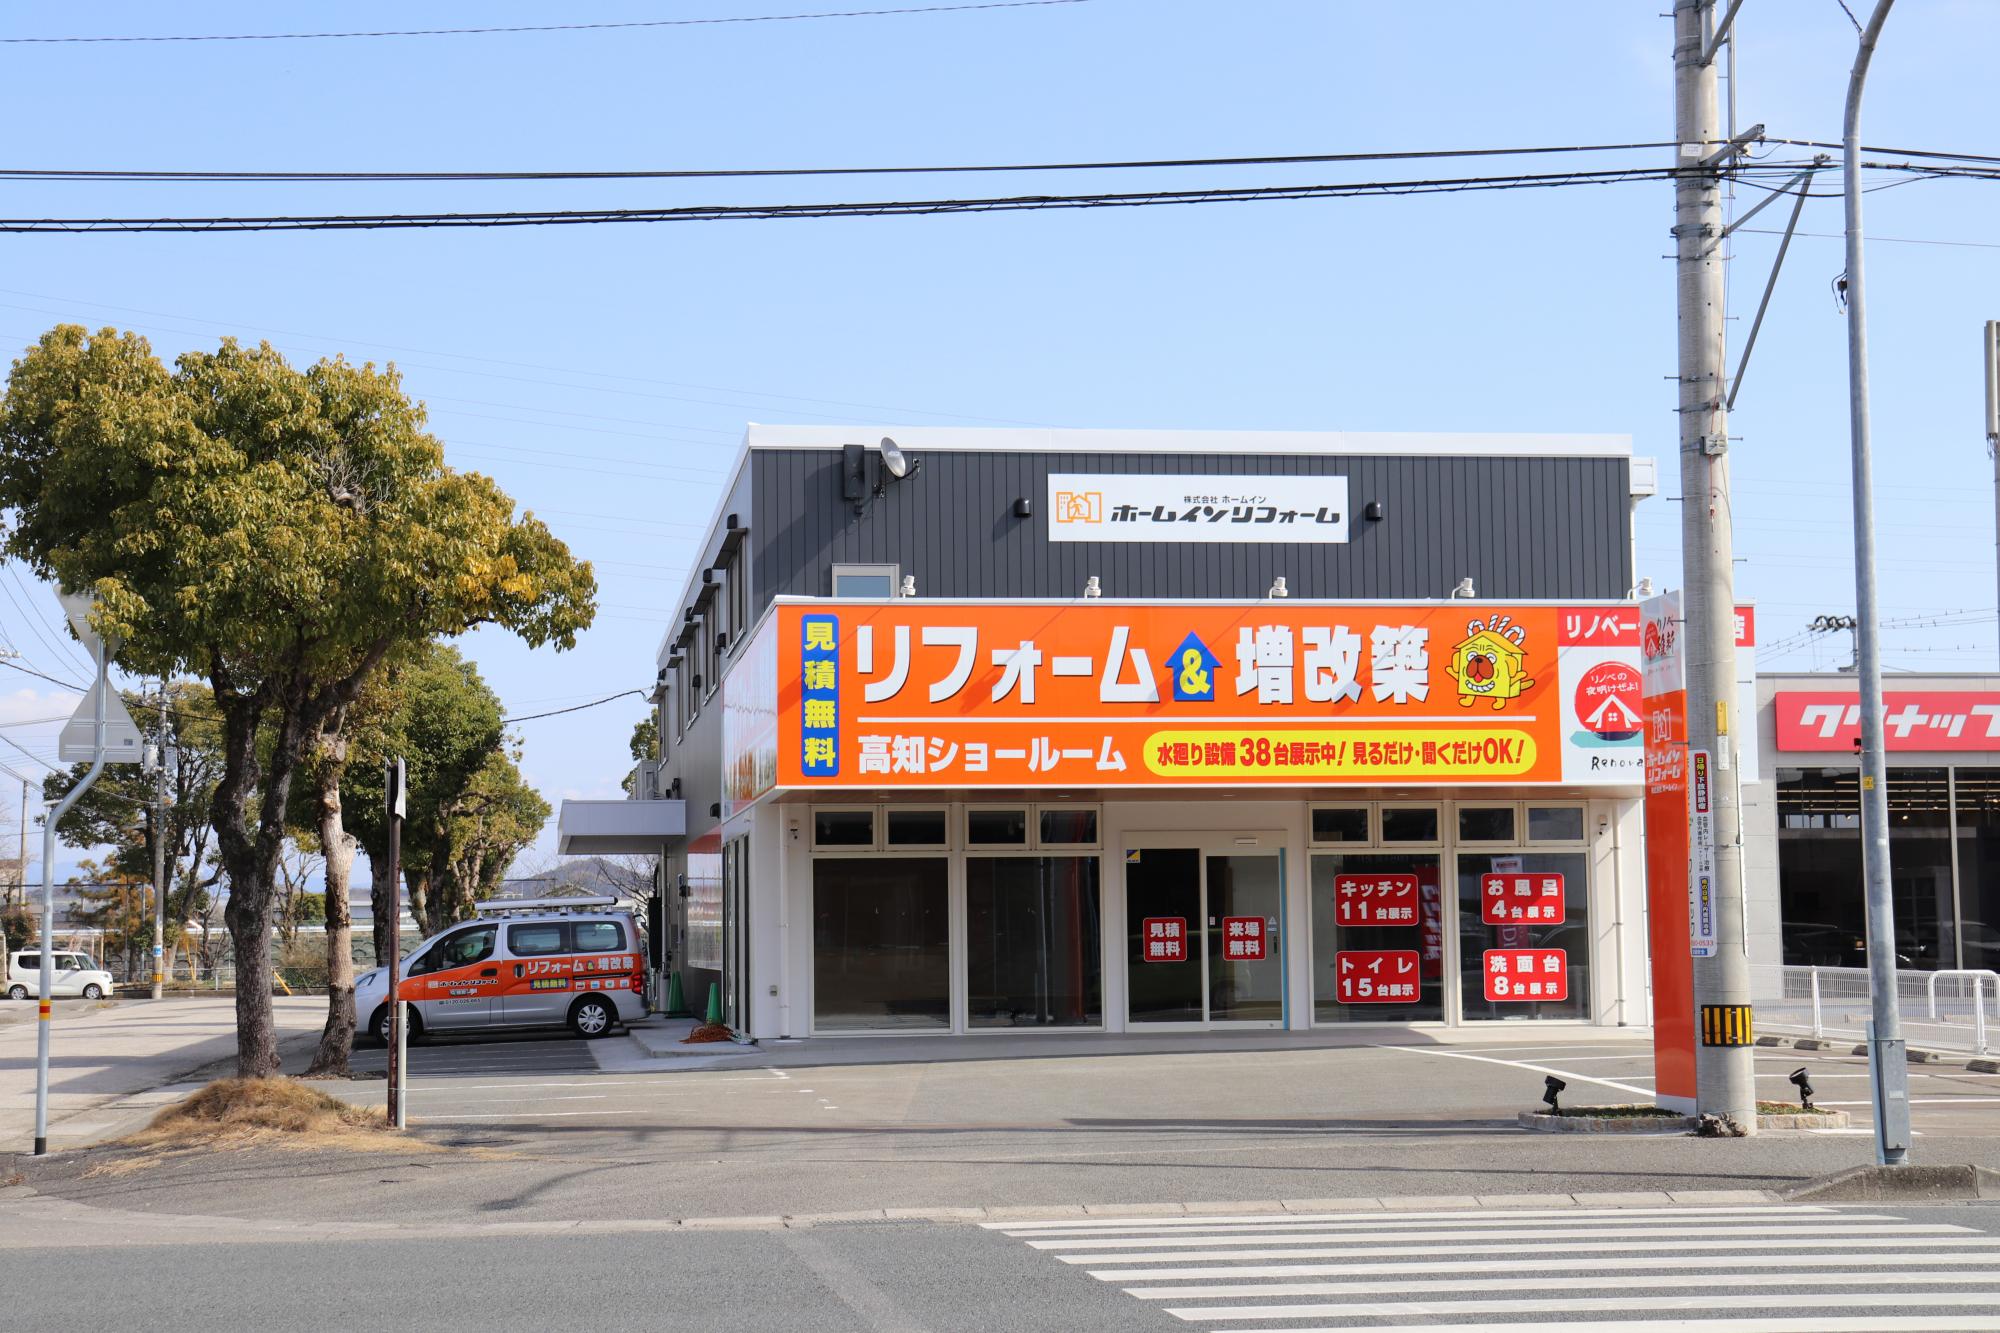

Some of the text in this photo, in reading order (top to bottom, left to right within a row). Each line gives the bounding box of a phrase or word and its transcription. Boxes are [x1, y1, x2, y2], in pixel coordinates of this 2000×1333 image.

[1184, 496, 1267, 504] 株式会社 ホームイン
[1111, 505, 1341, 524] ホームインリフォーム
[1567, 615, 1640, 638] リノベー
[857, 625, 1160, 705] リフォーム
[1236, 624, 1429, 705] 増改築
[803, 621, 836, 768] 見積無料
[857, 734, 1127, 774] 高知ショールーム
[1341, 880, 1411, 897] キッチン
[1488, 879, 1558, 896] お風呂
[1150, 922, 1180, 937] 見積
[1229, 922, 1260, 937] 来場
[1150, 941, 1180, 956] 無料
[1229, 940, 1260, 956] 無料
[528, 959, 585, 975] リフォーム
[1341, 957, 1413, 974] トイレ
[1490, 955, 1560, 973] 洗面台
